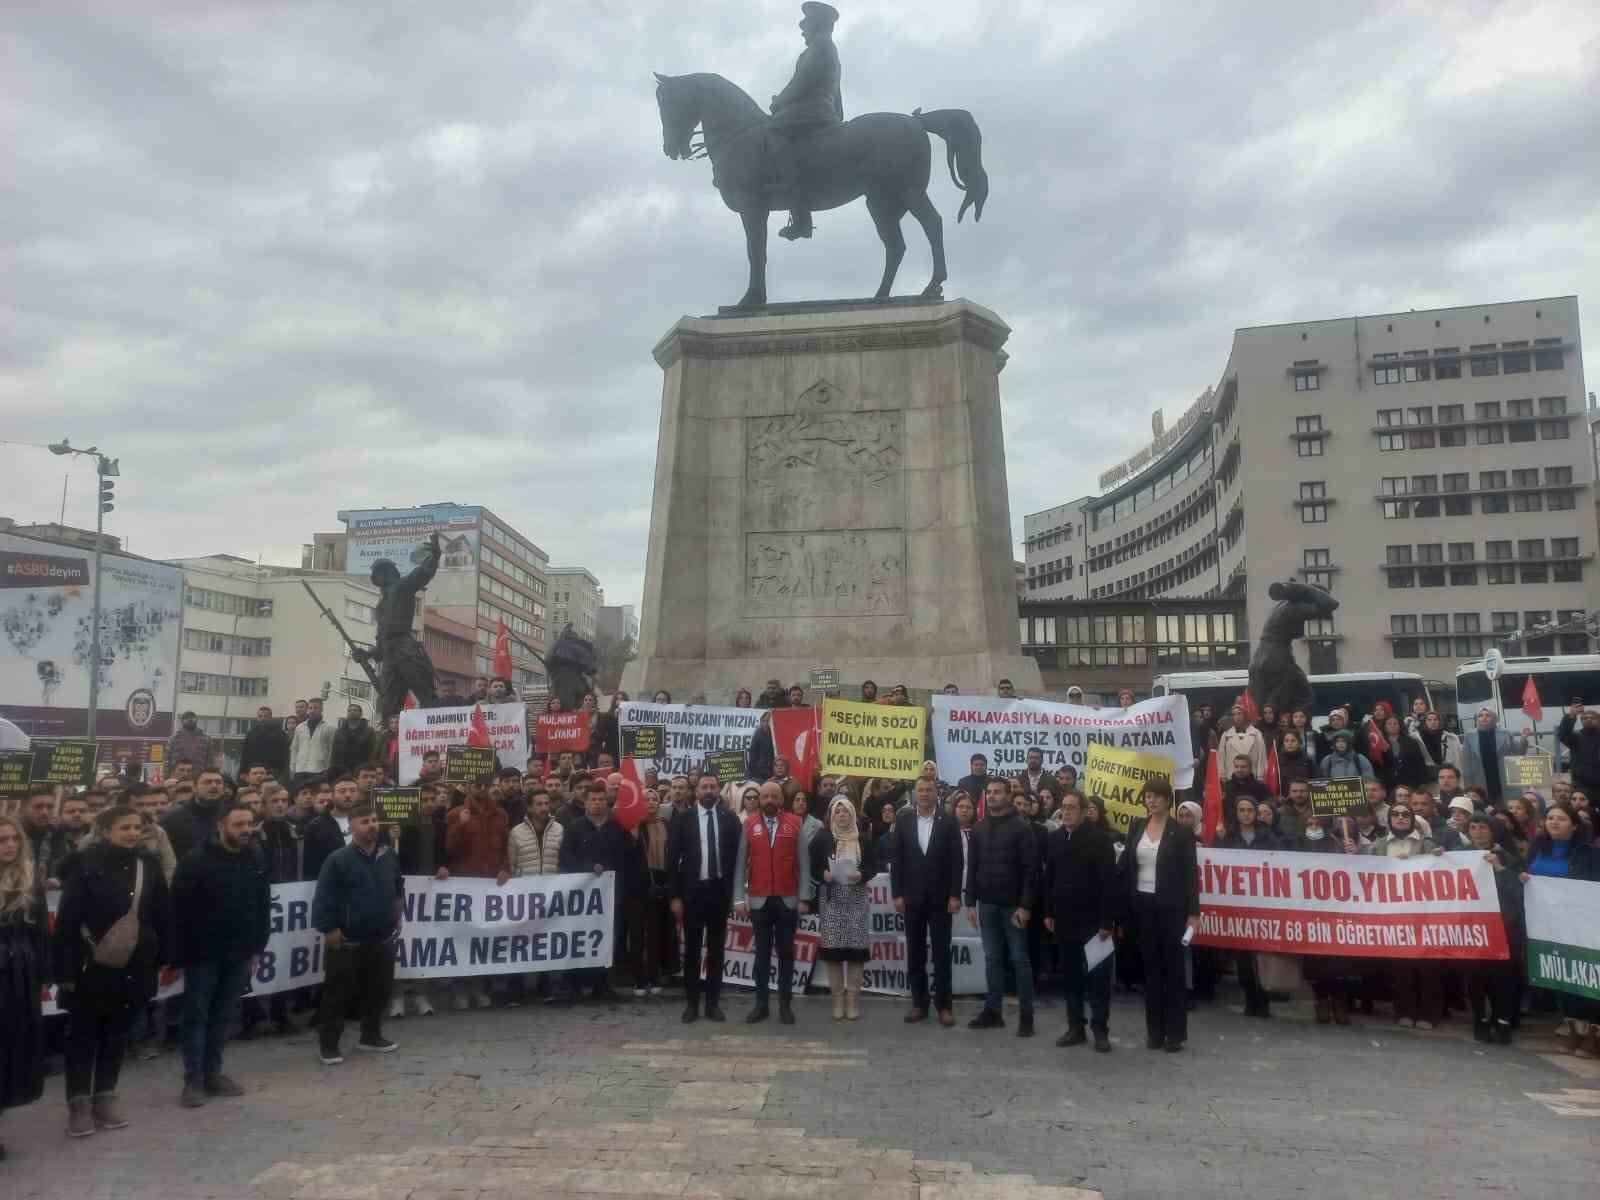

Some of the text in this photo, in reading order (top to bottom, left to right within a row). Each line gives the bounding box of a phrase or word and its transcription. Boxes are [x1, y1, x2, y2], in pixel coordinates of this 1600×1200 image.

[949, 710, 1049, 725] BAKLAVASIYLA
[828, 731, 919, 750] MÜLAKATLAR
[948, 727, 1176, 747] MÜLAKATSIZ 100 BİN ATAMA
[1298, 869, 1480, 903] 100.YILINDA
[485, 888, 604, 922] BURADA
[1200, 911, 1489, 947] MÜLAKATSIZ 68 BİN ÖĞRETMEN ATAMASI
[470, 930, 604, 965] NEREDE?
